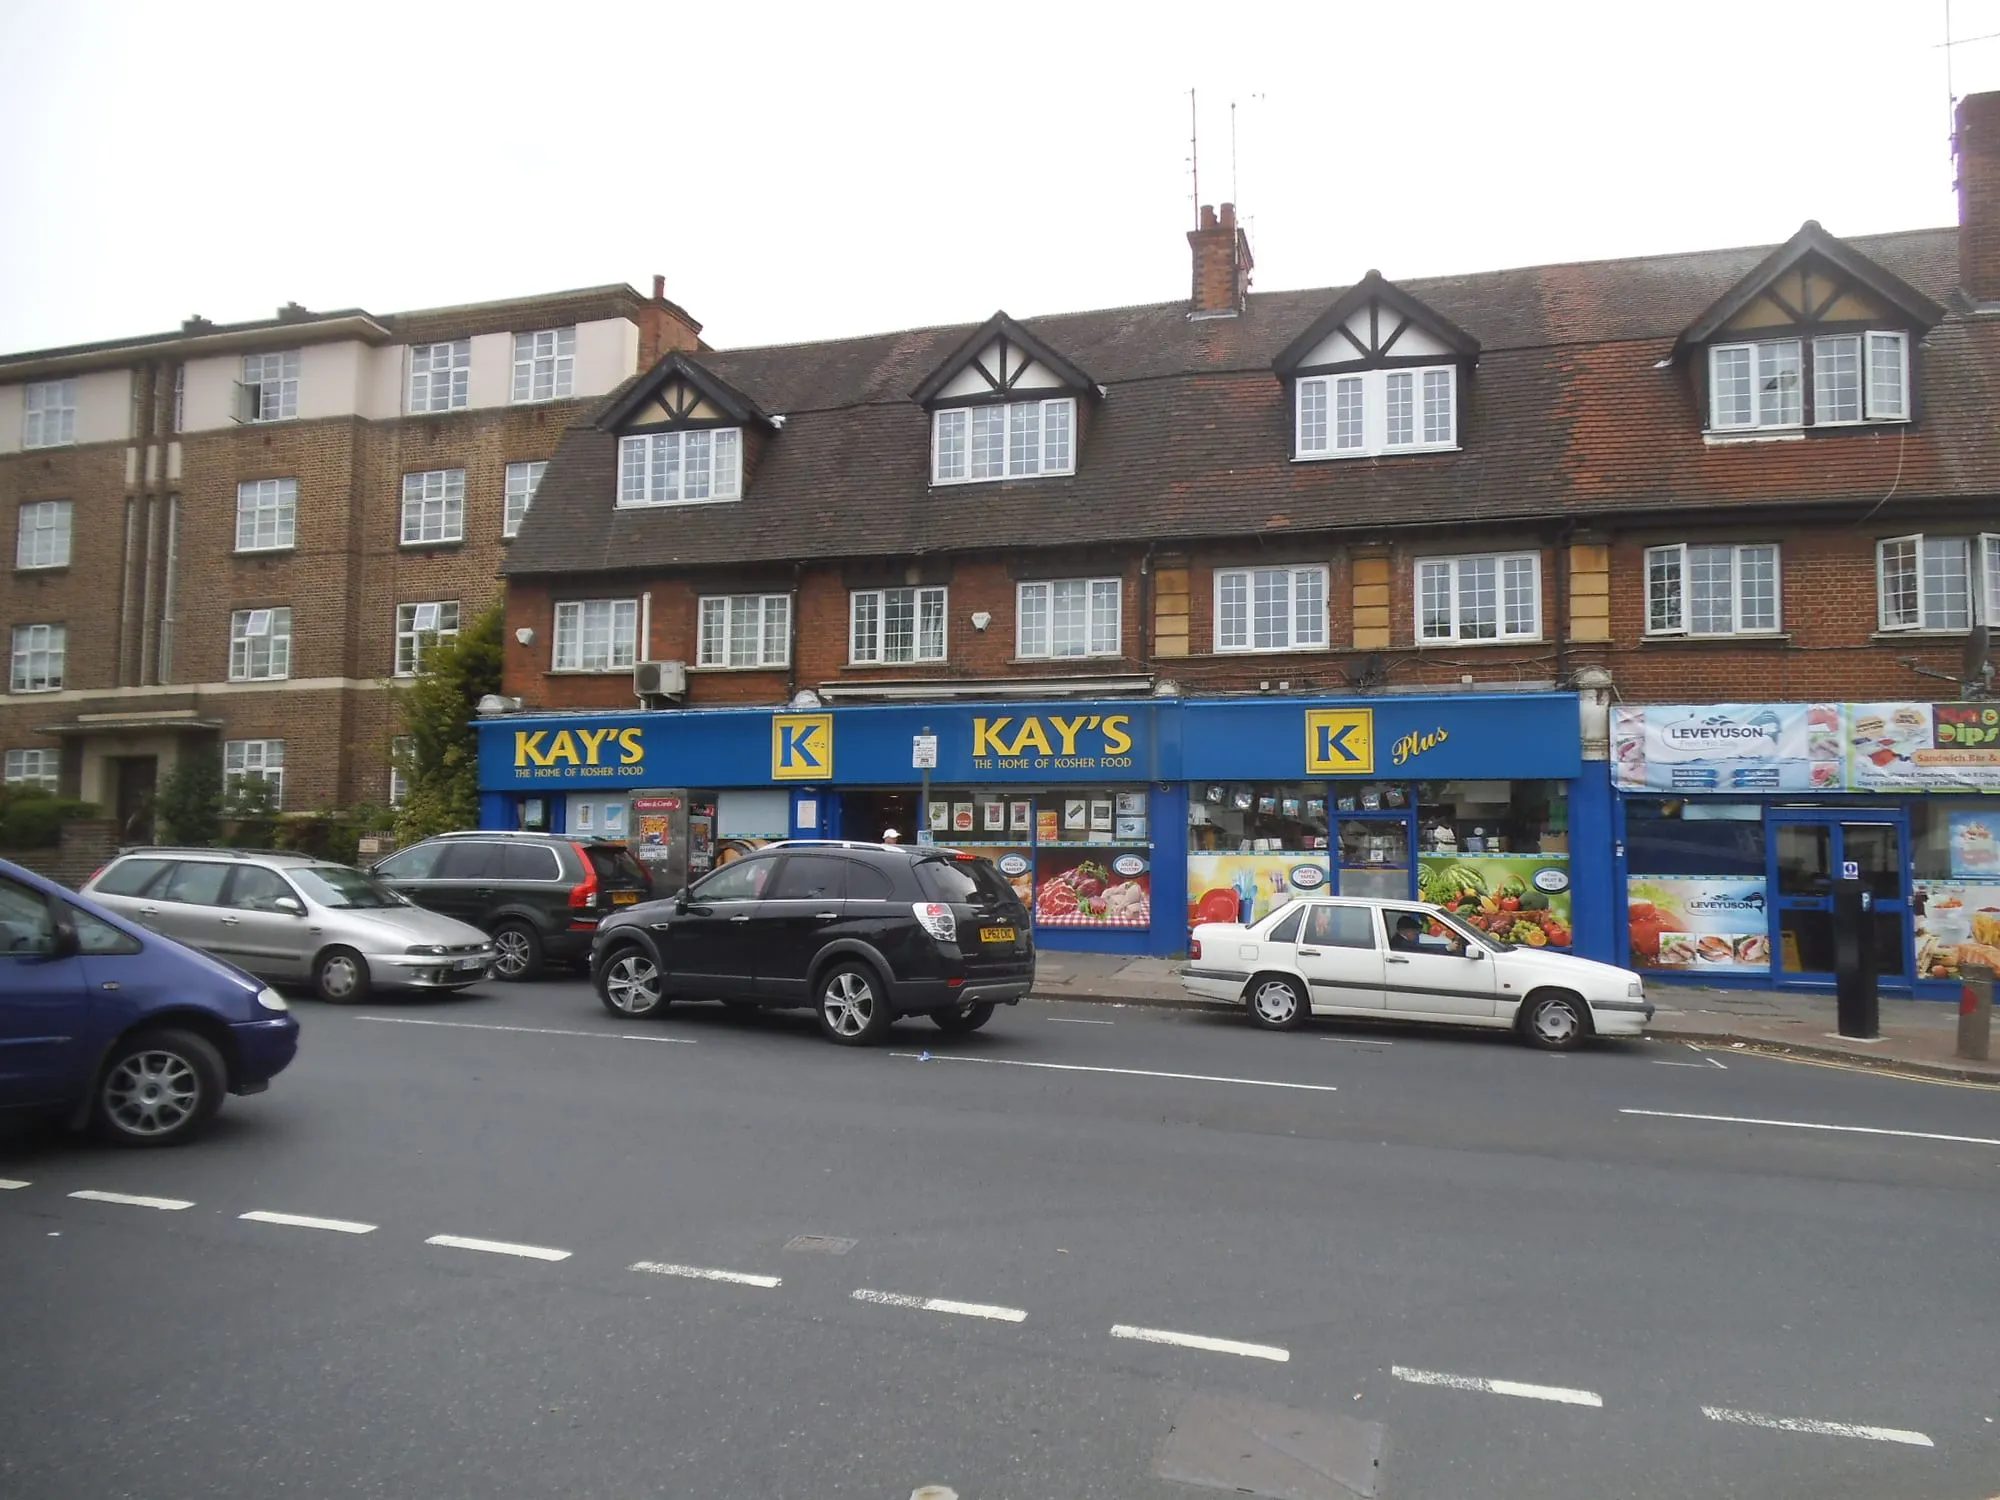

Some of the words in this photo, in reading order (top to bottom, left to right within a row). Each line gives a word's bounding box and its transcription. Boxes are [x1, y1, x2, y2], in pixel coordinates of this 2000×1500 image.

[972, 715, 1132, 756] KAY'S
[1317, 725, 1360, 761] K
[1672, 727, 1764, 739] LEVEYUSON
[514, 728, 645, 766] KAY'S
[779, 726, 821, 767] K
[1392, 725, 1449, 766] Plus
[974, 759, 992, 769] THE
[998, 759, 1029, 769] HOME
[1034, 759, 1049, 769] OF
[1054, 758, 1095, 768] KOSHER
[1100, 757, 1132, 767] FOOD
[1918, 754, 1966, 762] Sandwich
[515, 769, 531, 778] THE
[534, 768, 561, 777] HOME
[565, 767, 577, 776] OF
[580, 767, 614, 776] KOSHER
[617, 766, 644, 775] FOOD
[1690, 901, 1753, 909] LEVEYUSON
